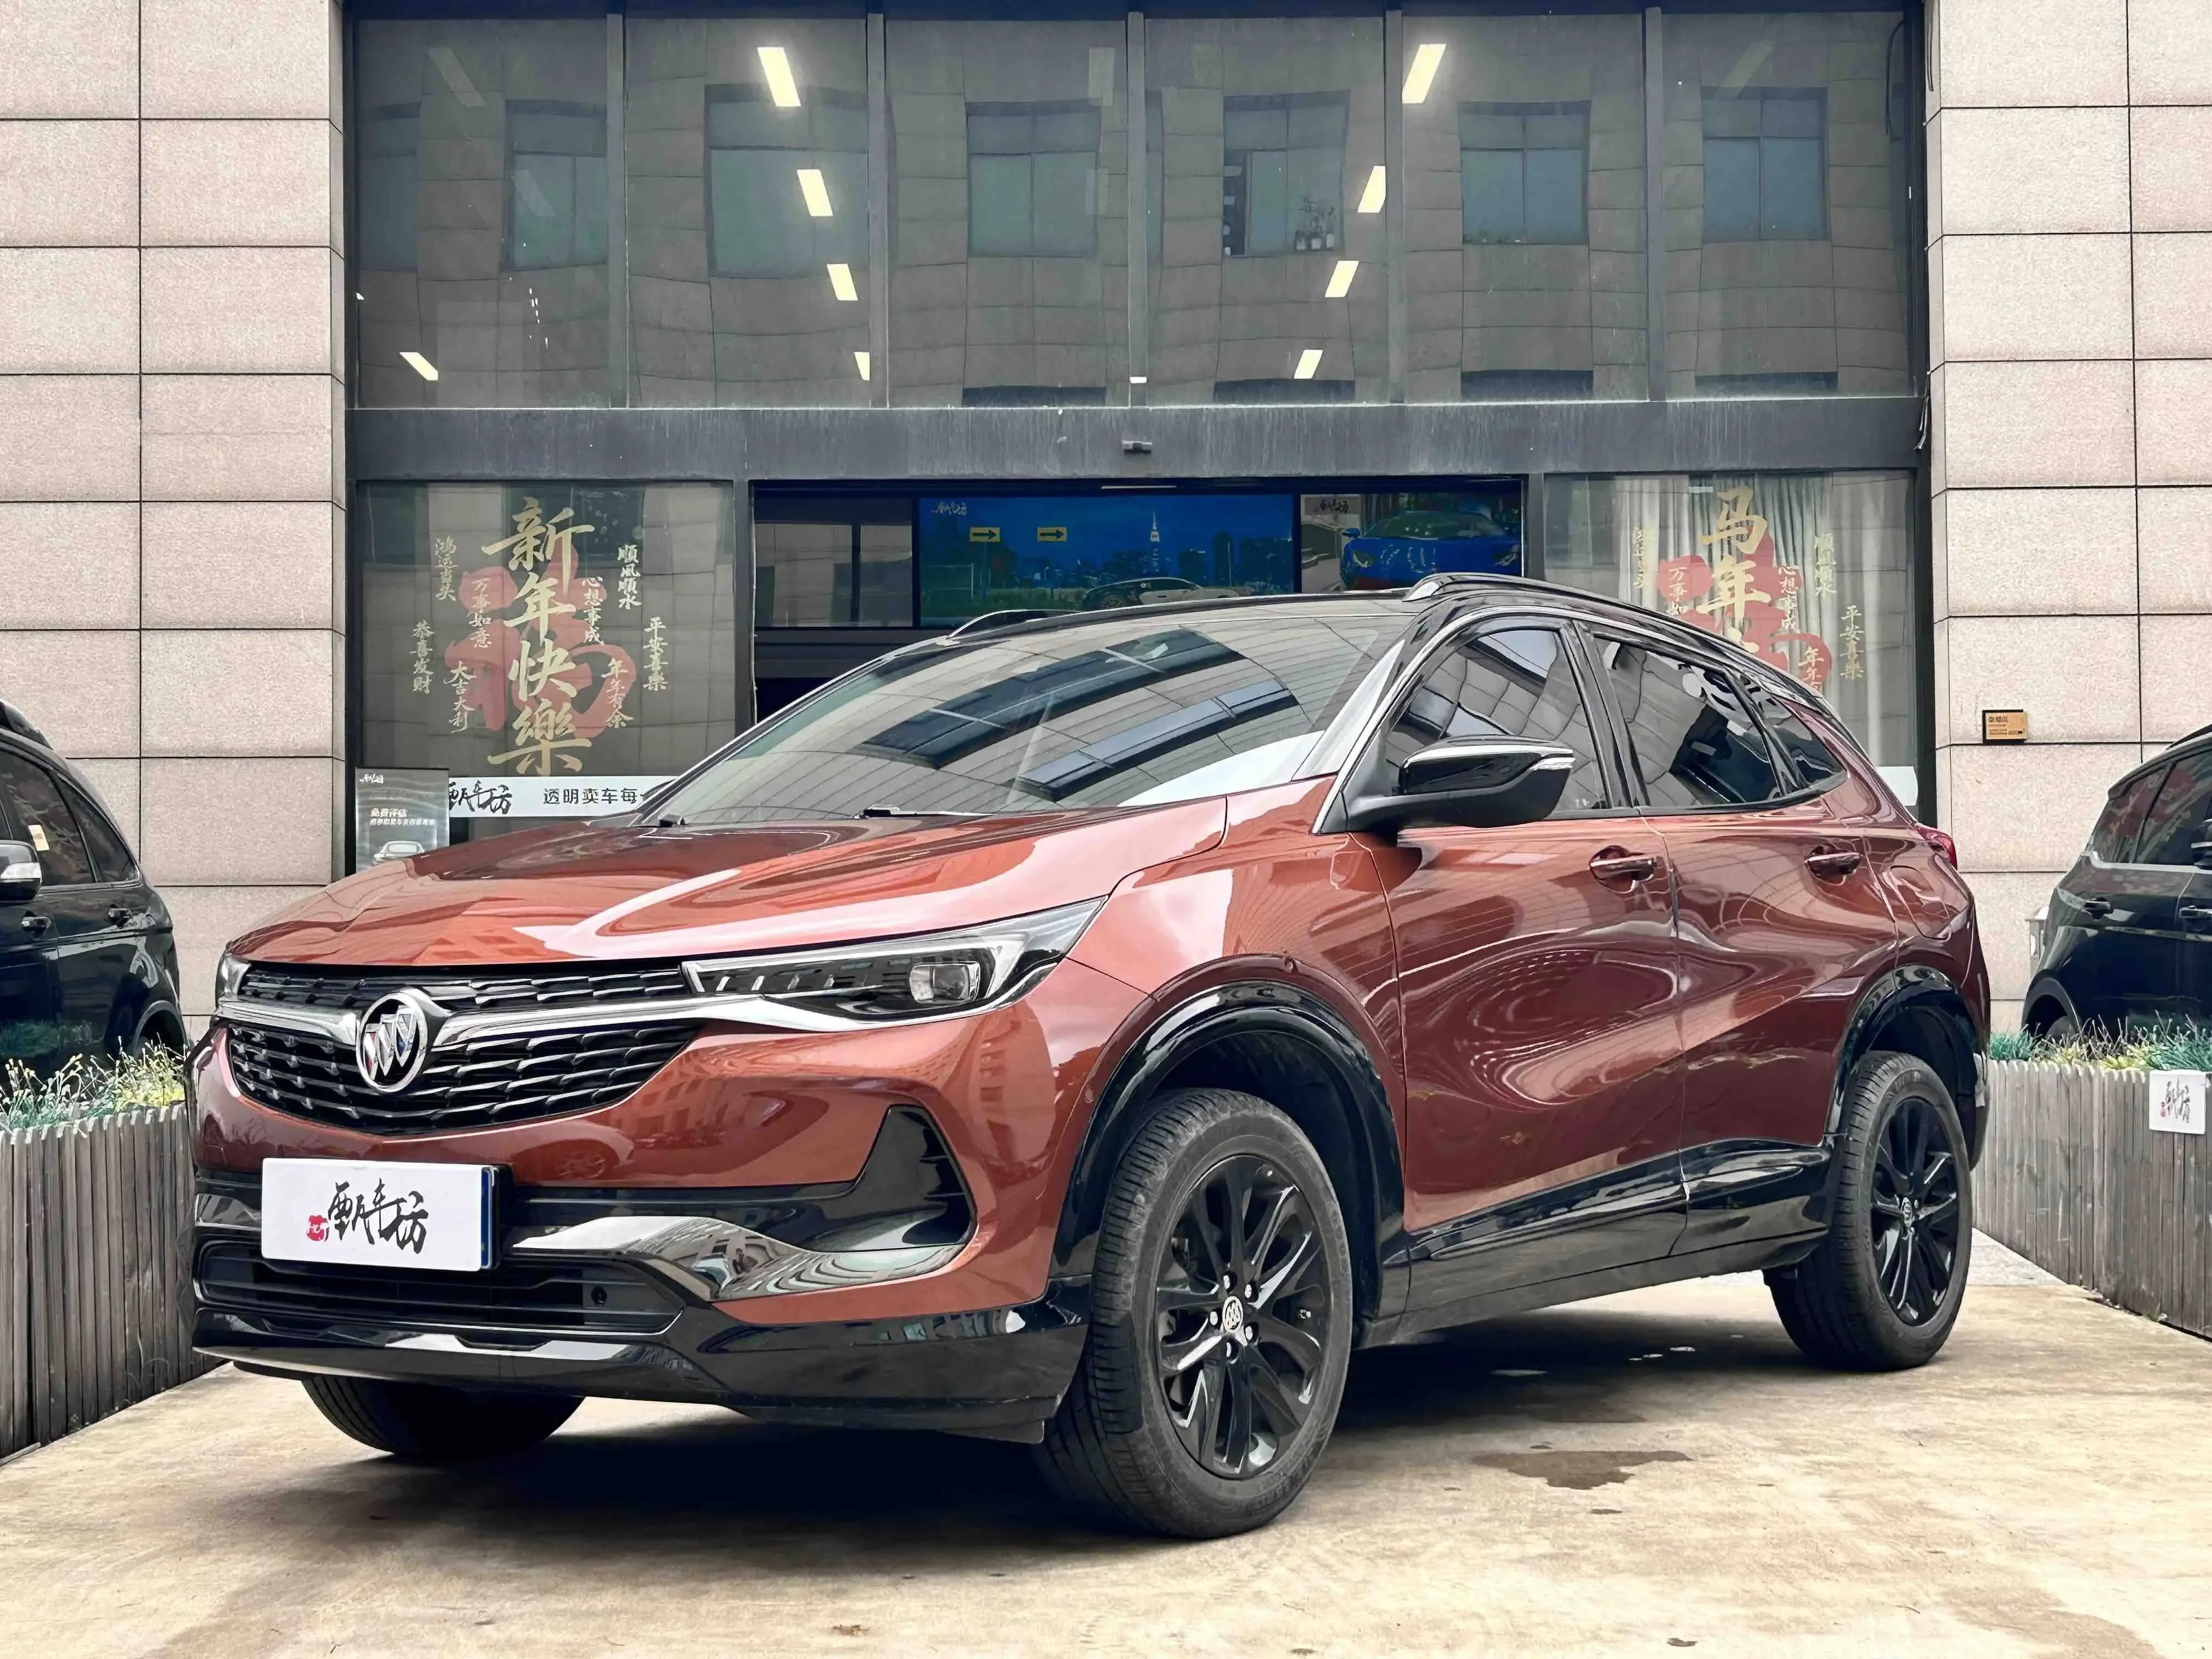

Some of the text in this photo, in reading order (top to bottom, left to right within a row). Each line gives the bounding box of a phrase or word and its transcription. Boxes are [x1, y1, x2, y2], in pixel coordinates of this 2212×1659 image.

[1697, 486, 1770, 653] 马年
[1779, 566, 1801, 634] 心想事成
[467, 578, 492, 648] 万事如意
[482, 496, 595, 774] 新年快樂
[582, 575, 605, 646] 心想事成
[409, 619, 435, 694] 恭喜发财
[443, 660, 478, 733] 大吉大利
[601, 657, 634, 729] 年年有余
[543, 787, 646, 805] 透明卖车每
